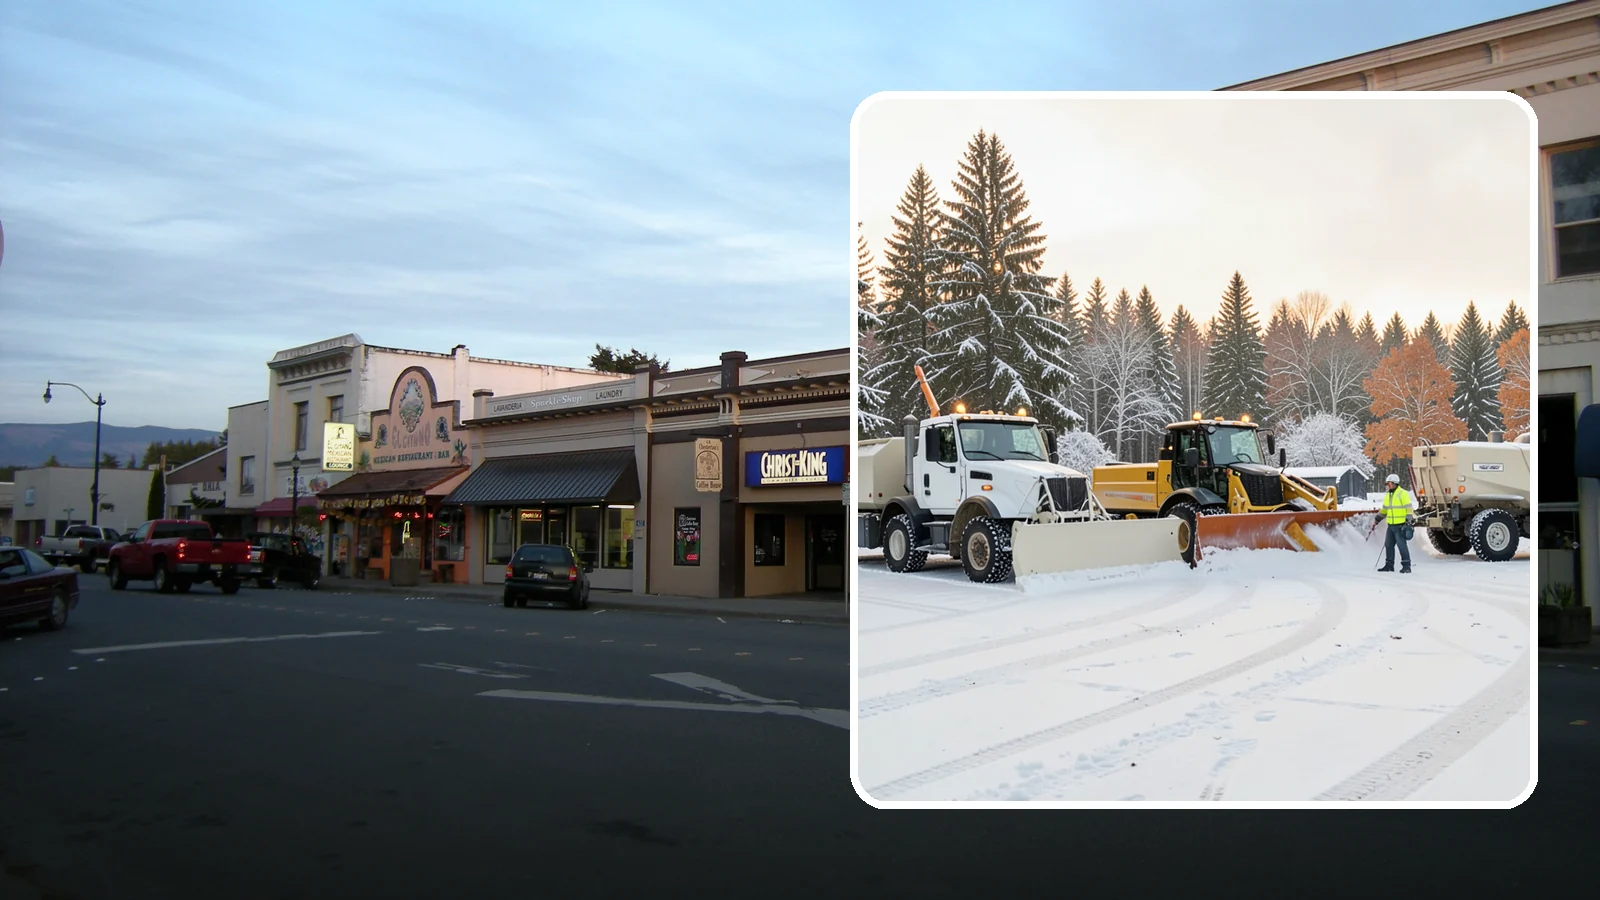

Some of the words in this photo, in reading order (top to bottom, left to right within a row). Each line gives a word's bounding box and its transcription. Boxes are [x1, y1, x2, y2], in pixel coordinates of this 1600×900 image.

[531, 396, 560, 409] Sparkle
[561, 394, 583, 405] Shop
[595, 389, 624, 400] LAUNDRY
[493, 402, 522, 413] LAVANDERIA
[373, 455, 396, 464] MEXICAN
[397, 451, 433, 462] RESTAURANT
[438, 450, 450, 459] BAR
[760, 452, 798, 478] CHRIST
[799, 450, 827, 477] KING
